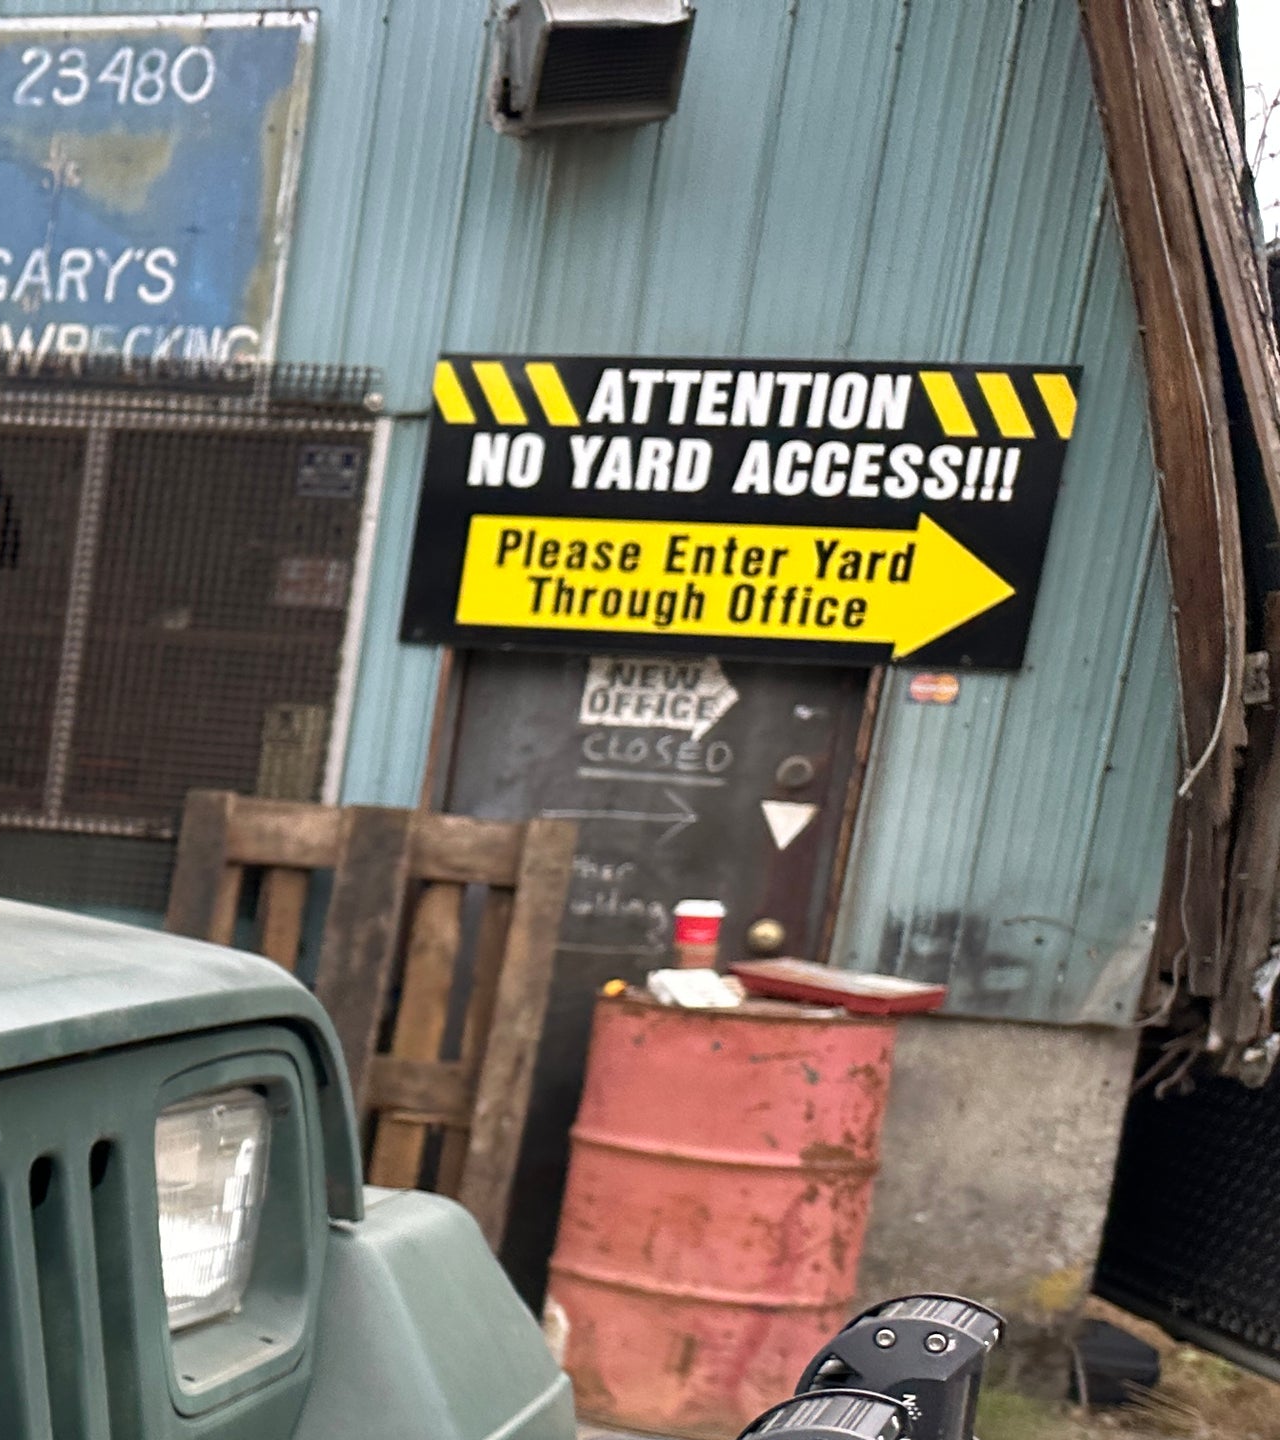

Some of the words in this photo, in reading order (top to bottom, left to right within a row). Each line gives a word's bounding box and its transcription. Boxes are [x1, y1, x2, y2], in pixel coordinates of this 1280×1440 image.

[13, 45, 217, 107] 23480
[586, 368, 913, 431] ATTENTION
[467, 432, 545, 488] NO
[570, 435, 713, 493] YARD
[732, 440, 1022, 502] ACCESS!!!
[496, 528, 642, 572] Please
[664, 534, 789, 578] Enter
[816, 540, 916, 583] Yard
[530, 576, 706, 627] Through
[728, 584, 868, 629] Office
[589, 687, 719, 720] OFFICE
[607, 662, 703, 690] NEW
